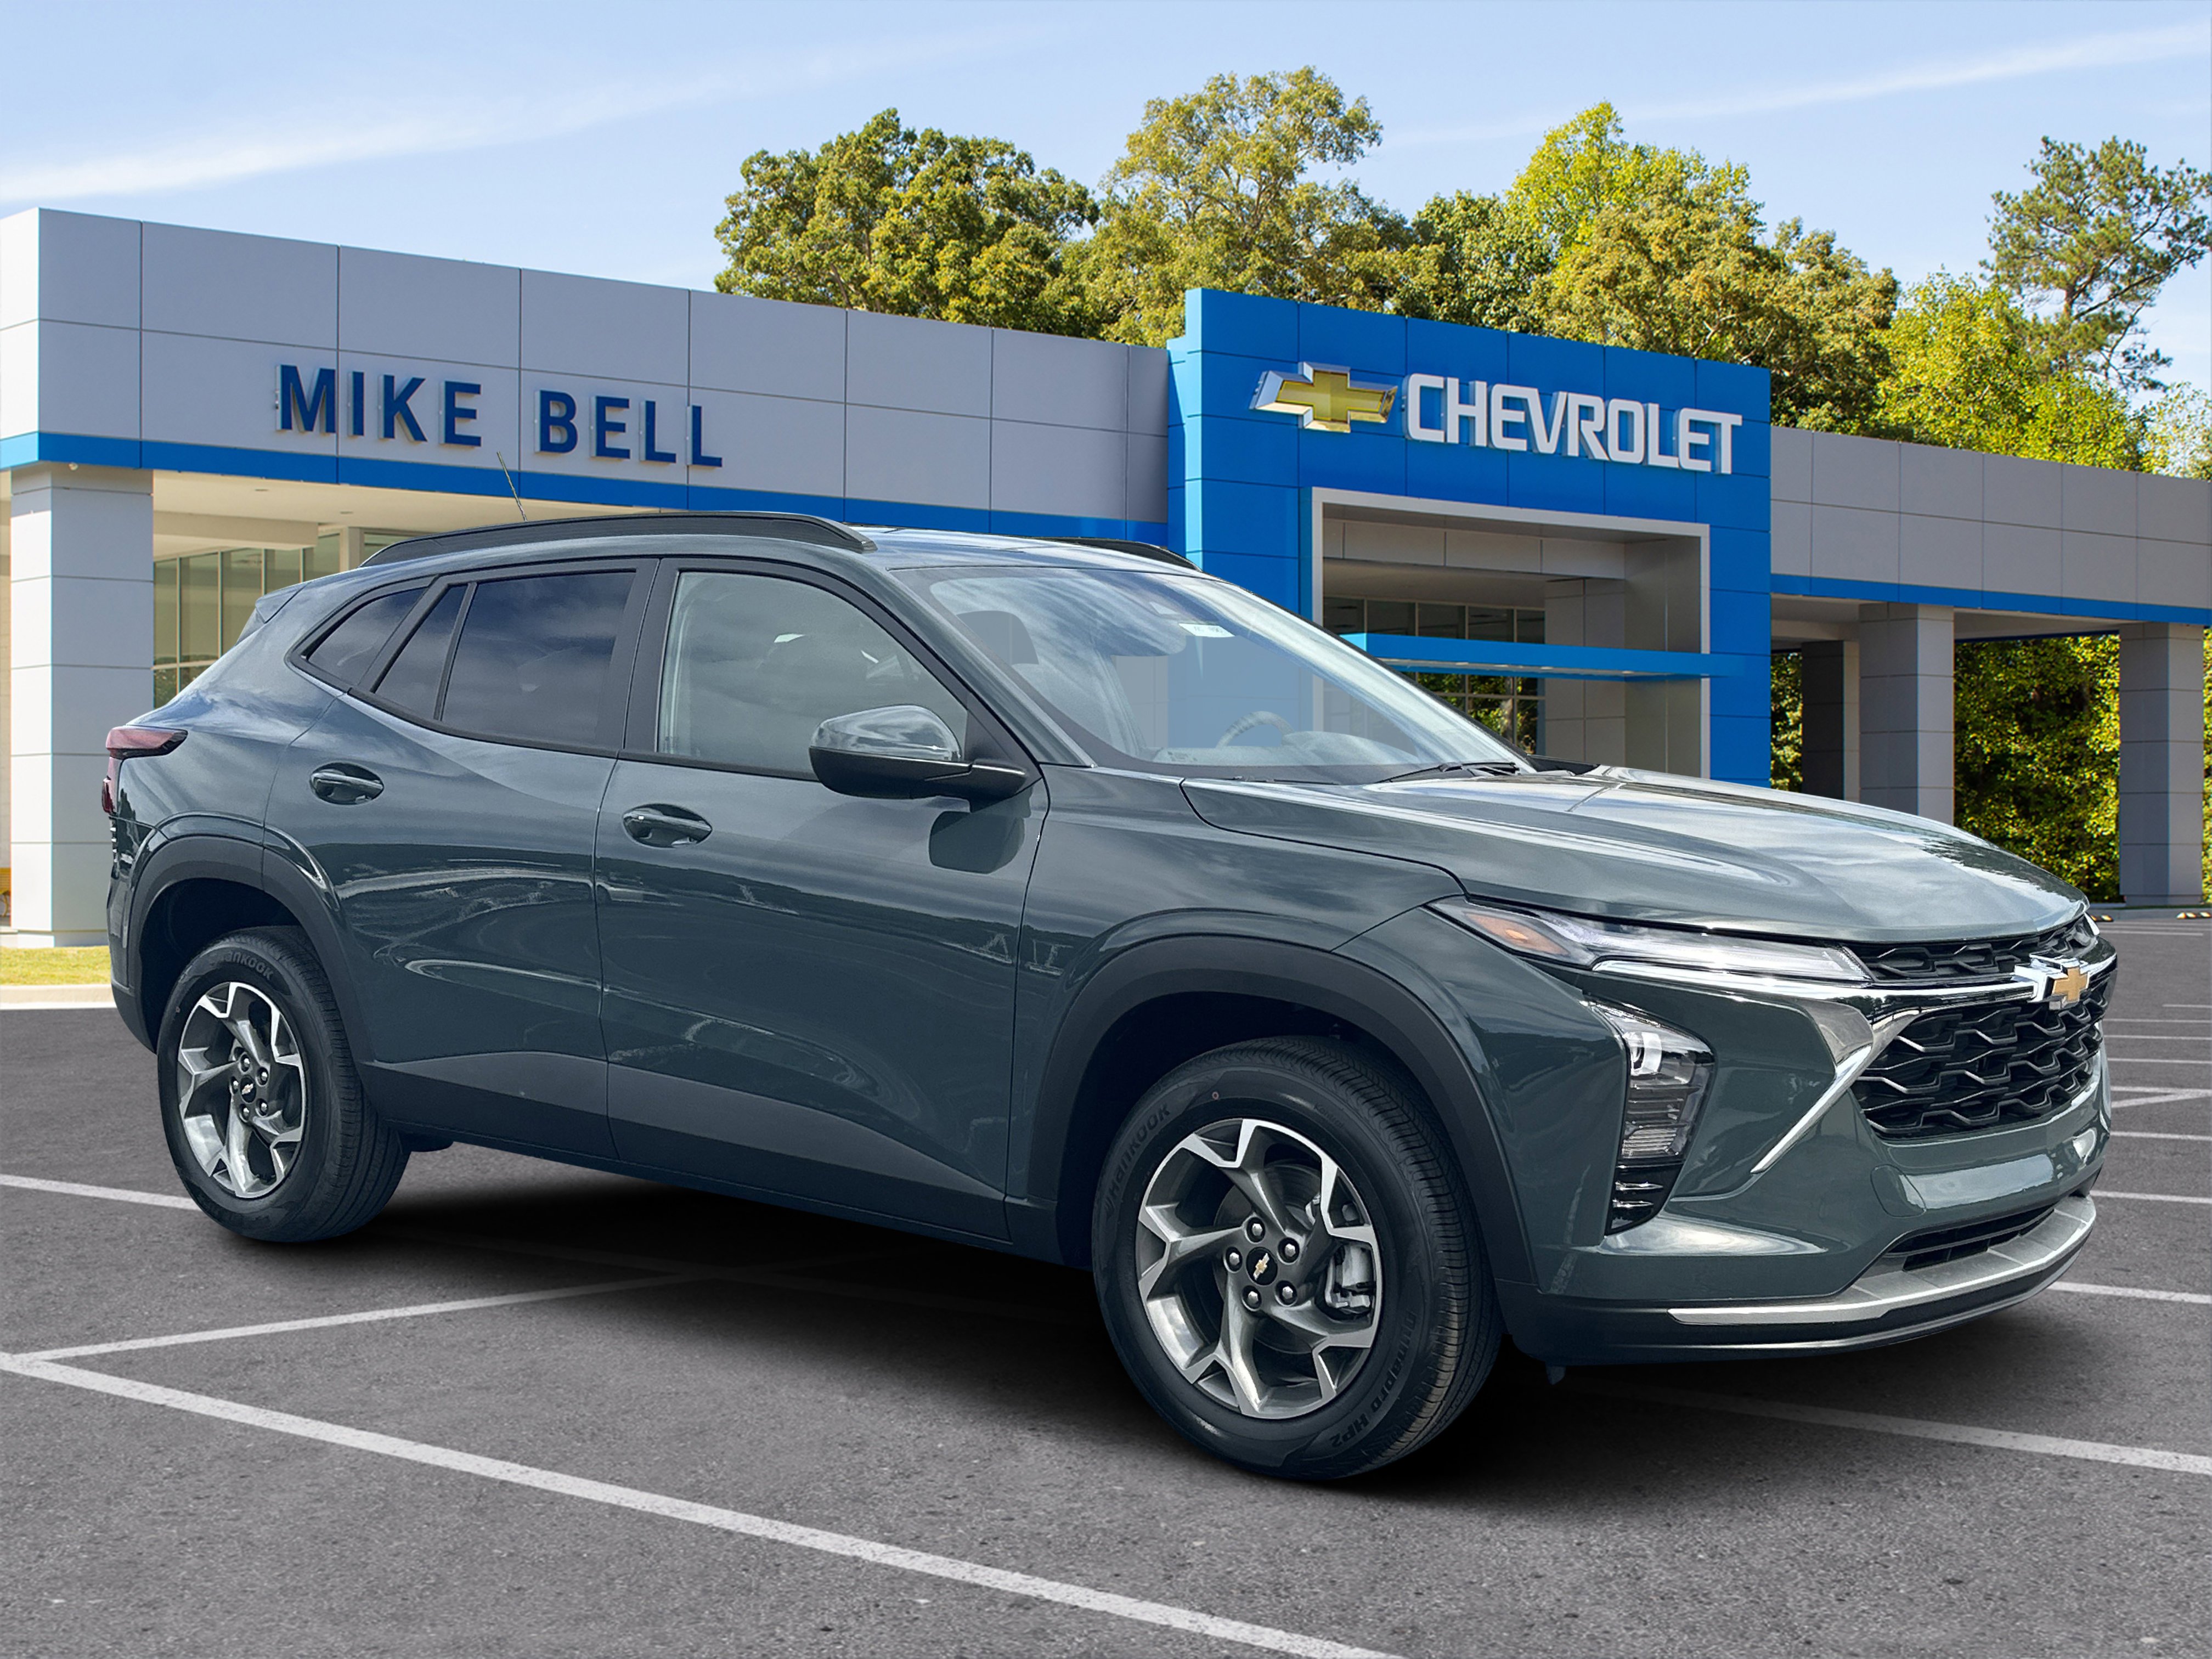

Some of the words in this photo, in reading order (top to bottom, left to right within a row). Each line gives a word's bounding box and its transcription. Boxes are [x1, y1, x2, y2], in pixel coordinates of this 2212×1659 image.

[275, 364, 483, 448] MIKE
[534, 389, 724, 468] BELL
[1401, 372, 1743, 475] CHEVROLET
